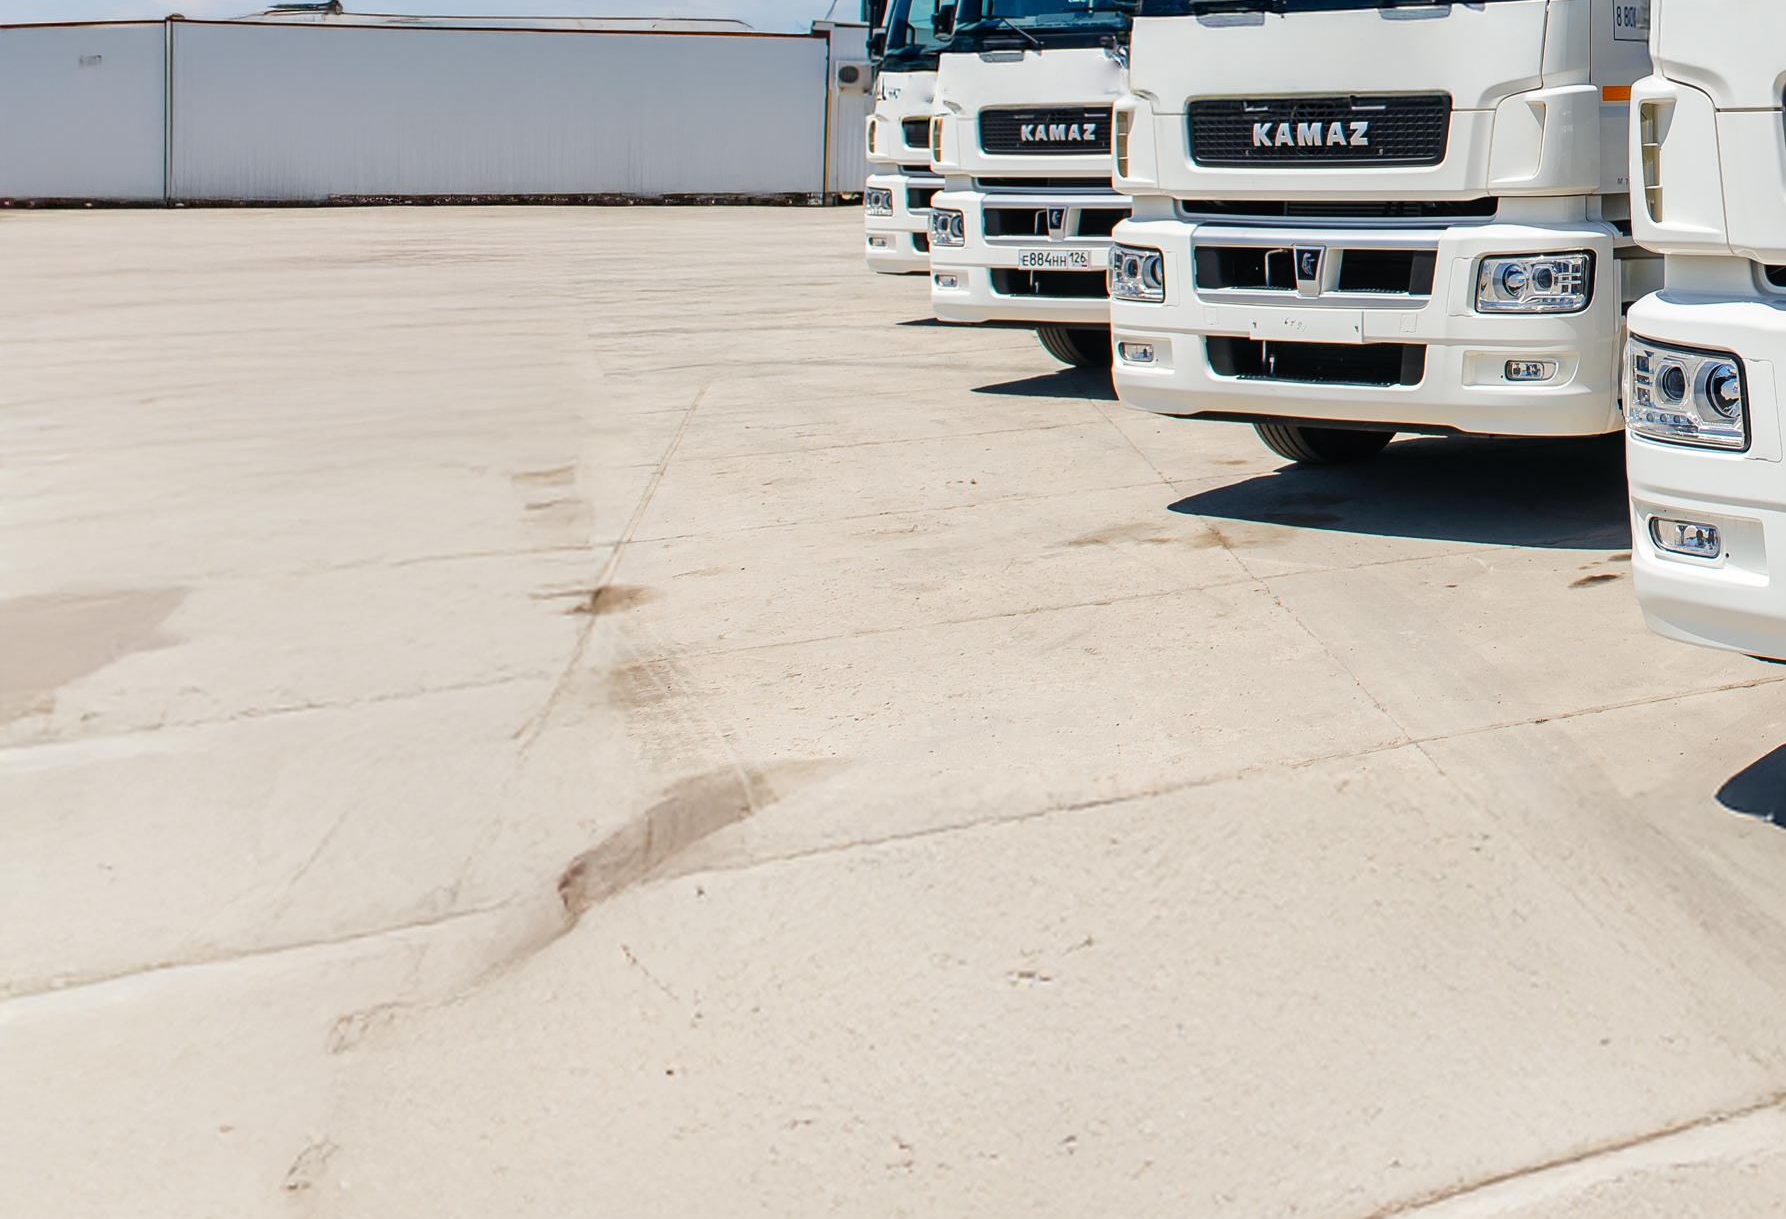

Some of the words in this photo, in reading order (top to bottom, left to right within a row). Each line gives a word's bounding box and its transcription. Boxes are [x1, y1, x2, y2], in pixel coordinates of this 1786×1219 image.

[1021, 123, 1097, 142] KAMAZ
[1252, 121, 1369, 147] KAMAZ
[1068, 251, 1088, 263] 126
